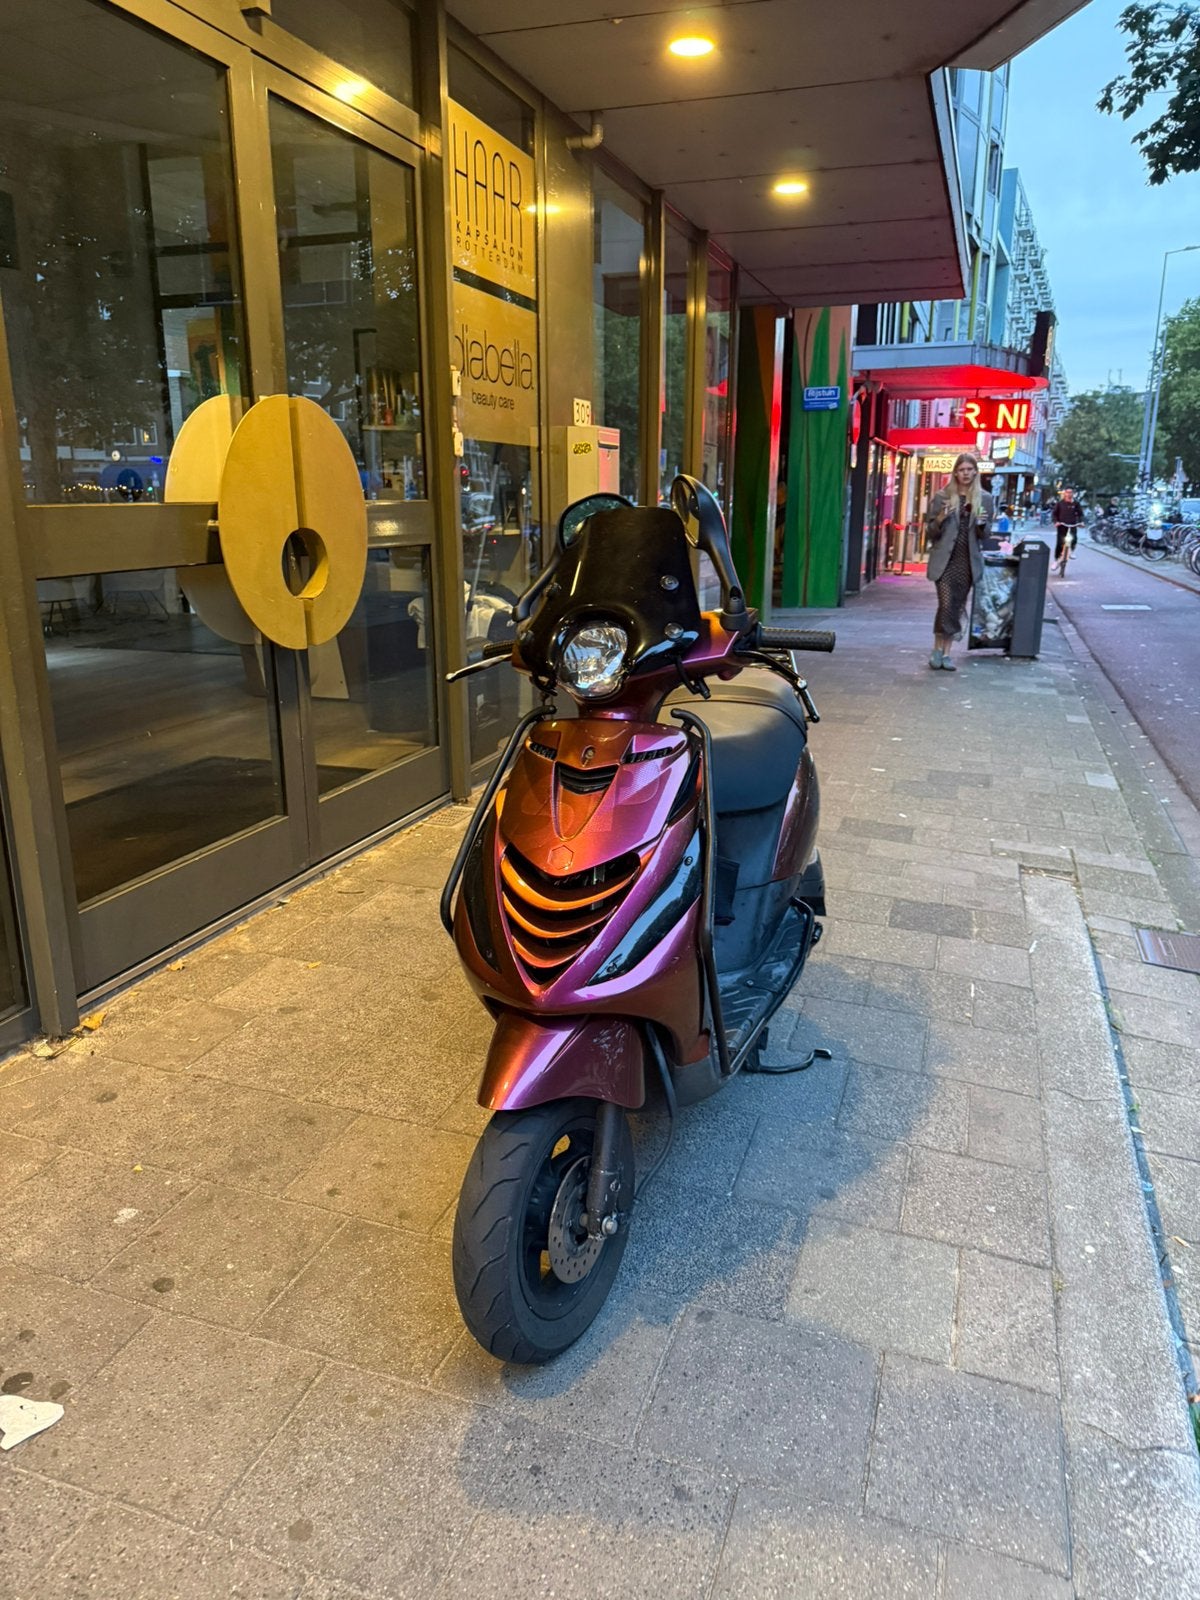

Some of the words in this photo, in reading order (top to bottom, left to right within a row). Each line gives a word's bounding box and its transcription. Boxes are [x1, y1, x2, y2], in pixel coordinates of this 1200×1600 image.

[452, 122, 523, 249] HAAR
[456, 219, 523, 263] KAPSALON
[456, 235, 524, 276] ROTTERDAM
[471, 388, 498, 410] beauty
[498, 395, 516, 410] care
[575, 401, 590, 425] 309
[996, 403, 1028, 429] NI
[925, 459, 954, 470] MASS
